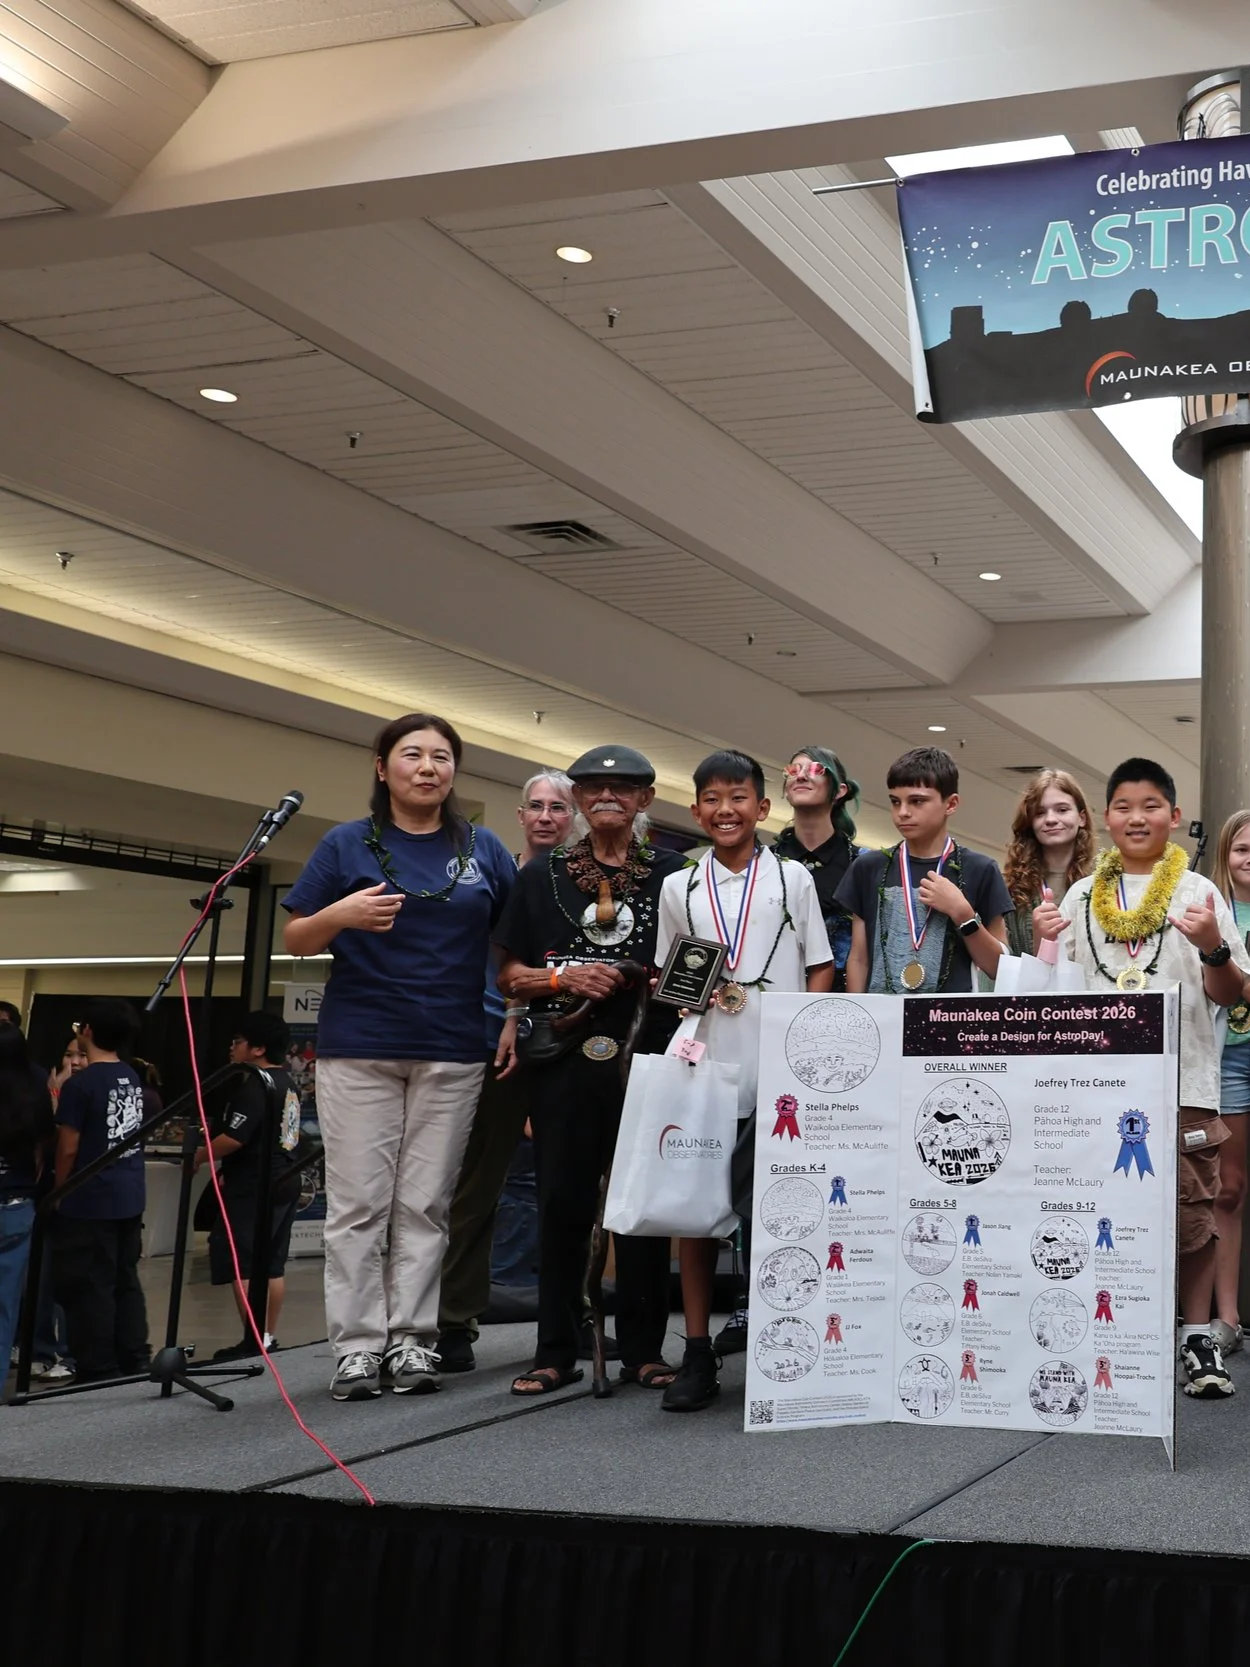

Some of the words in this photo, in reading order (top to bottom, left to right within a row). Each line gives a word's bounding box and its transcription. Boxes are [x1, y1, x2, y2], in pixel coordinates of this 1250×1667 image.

[1096, 165, 1213, 198] Celebrating
[1100, 358, 1218, 385] MAUNAKEA
[295, 998, 321, 1011] NE
[929, 1009, 1000, 1022] Maunakea
[1004, 1008, 1036, 1021] Coin
[1041, 1007, 1098, 1020] Contest
[1102, 1006, 1136, 1020] 2026
[957, 1032, 990, 1041] Create
[1000, 1032, 1035, 1043] Design
[1037, 1031, 1051, 1041] for
[1054, 1031, 1104, 1042] AstroDay!
[924, 1063, 966, 1071] OVERALL
[970, 1063, 1007, 1071] WINNER
[1034, 1079, 1068, 1089] Joefrey
[1071, 1079, 1090, 1087] Trez
[1093, 1079, 1126, 1087] Canete
[805, 1103, 829, 1111] Stella
[832, 1103, 859, 1112] Phelps
[1034, 1105, 1059, 1113] Grade
[1061, 1105, 1069, 1113] 12
[1064, 1117, 1083, 1126] High
[1085, 1117, 1101, 1125] and
[1034, 1129, 1090, 1137] Intermediate
[667, 1138, 722, 1149] MAUNEA
[1034, 1141, 1064, 1149] School
[942, 1148, 980, 1161] MAUNA
[771, 1164, 806, 1172] Grades
[938, 1162, 961, 1176] KEA
[965, 1163, 996, 1174] 2026
[1034, 1165, 1071, 1174] Teacher:
[1034, 1177, 1064, 1186] Jeanne
[1066, 1178, 1104, 1188] McLaury
[910, 1199, 941, 1207] Grades
[1041, 1201, 1073, 1210] Grades
[1077, 1202, 1096, 1210] 9-12
